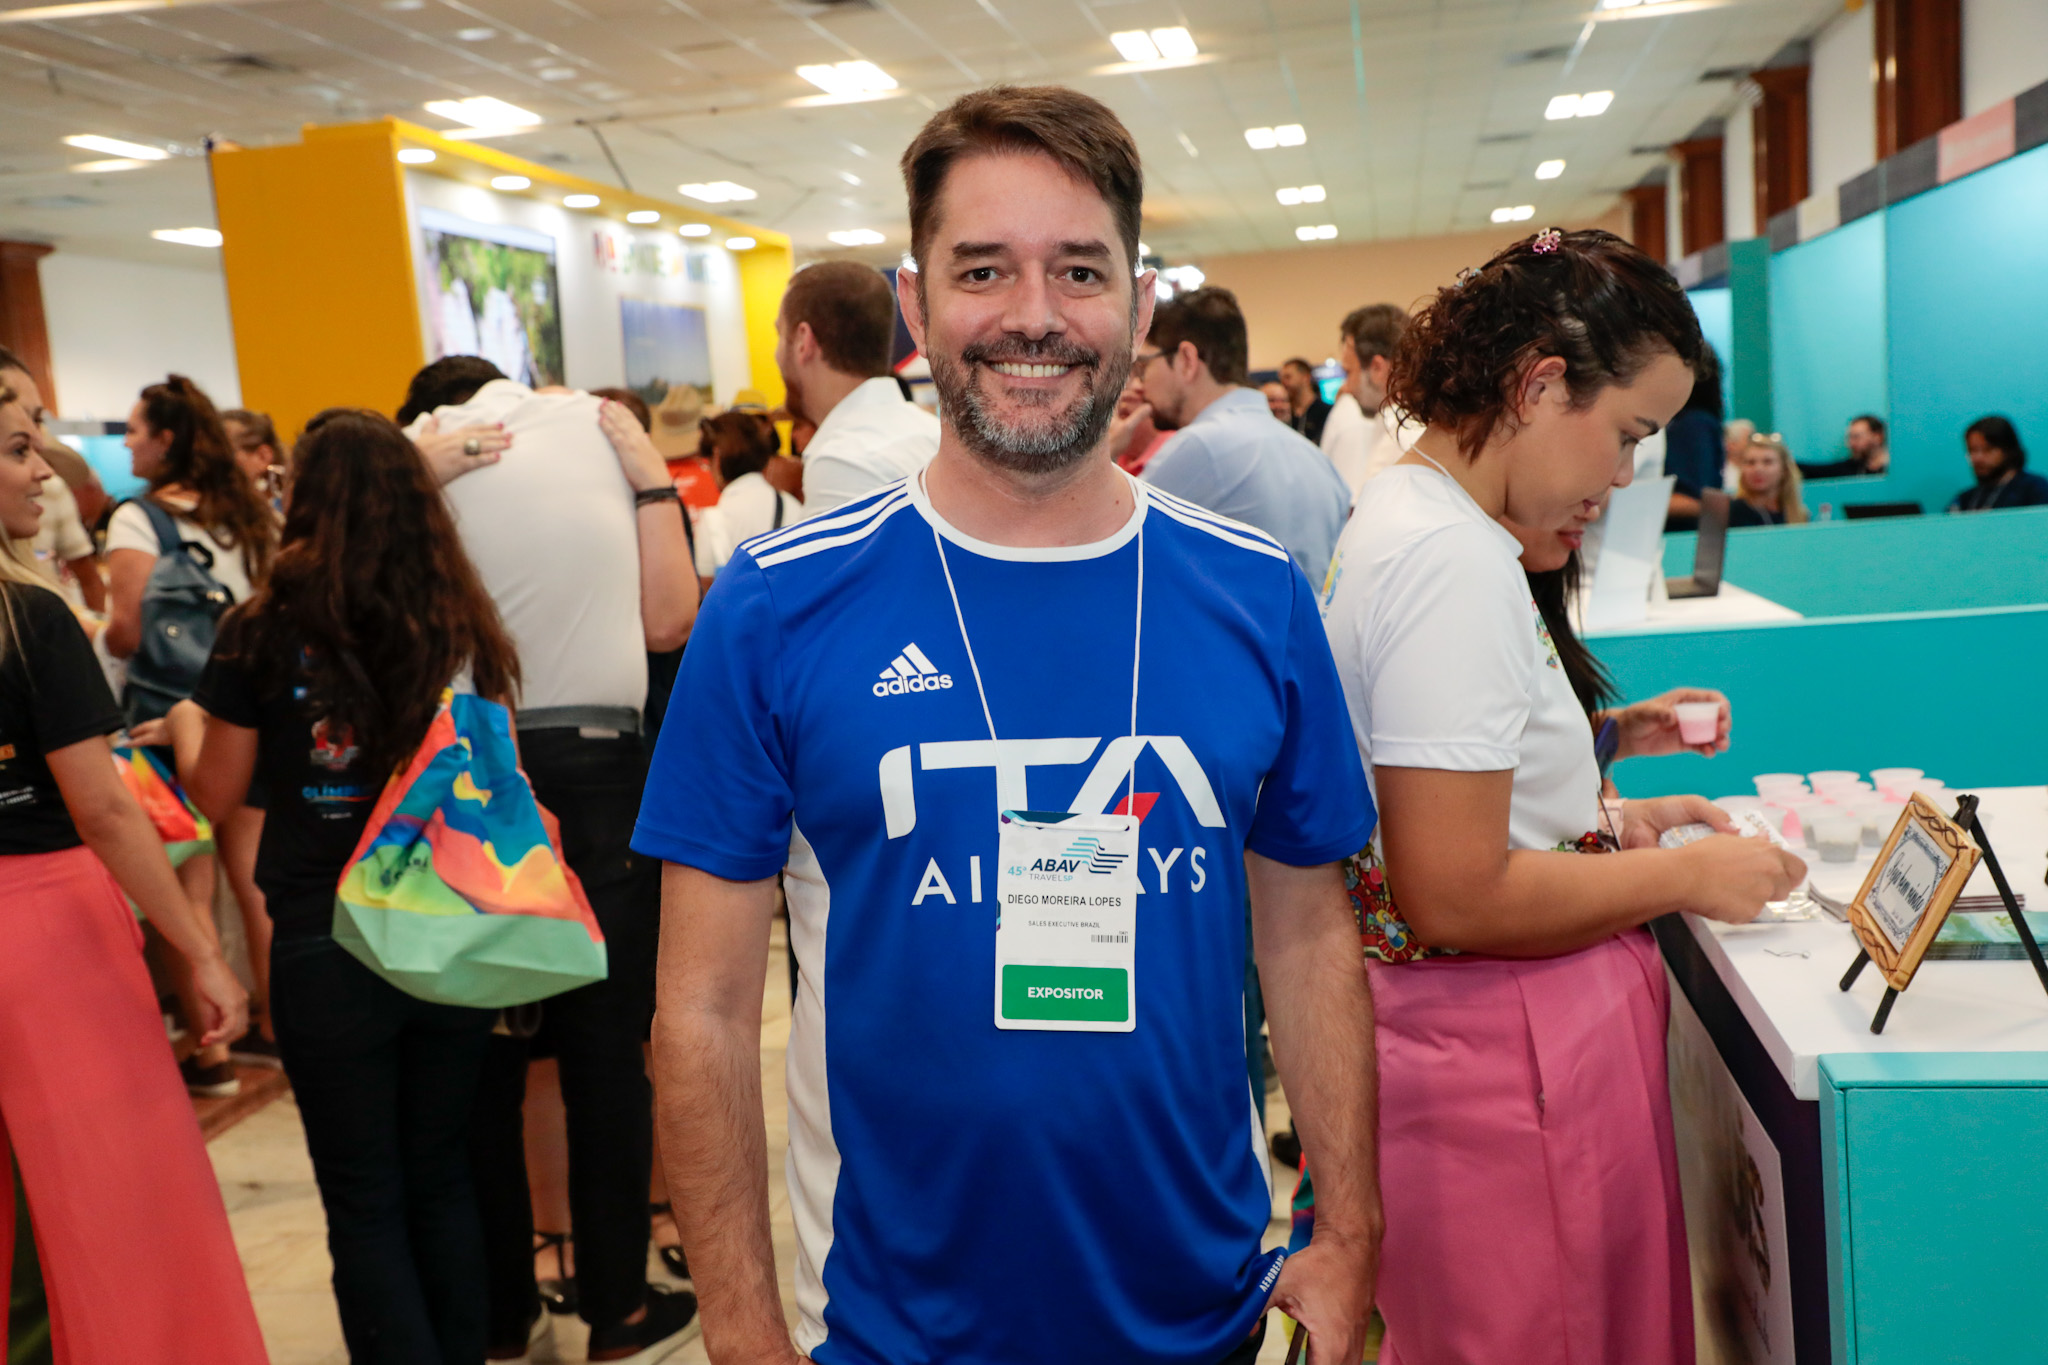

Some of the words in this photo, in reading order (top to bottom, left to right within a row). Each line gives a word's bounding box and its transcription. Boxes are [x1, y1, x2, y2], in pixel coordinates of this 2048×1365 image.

[872, 673, 954, 697] adidas
[879, 735, 1227, 840] ITA
[1030, 858, 1081, 873] ABAV
[911, 846, 1206, 906] AIYS
[1007, 894, 1039, 905] DIEGO
[1041, 895, 1087, 906] MOREIRA
[1089, 897, 1122, 907] LOPES
[1048, 920, 1079, 928] EXECUTIVE
[1080, 921, 1101, 929] BRAZIL
[1027, 986, 1104, 1000] EXPOSITOR
